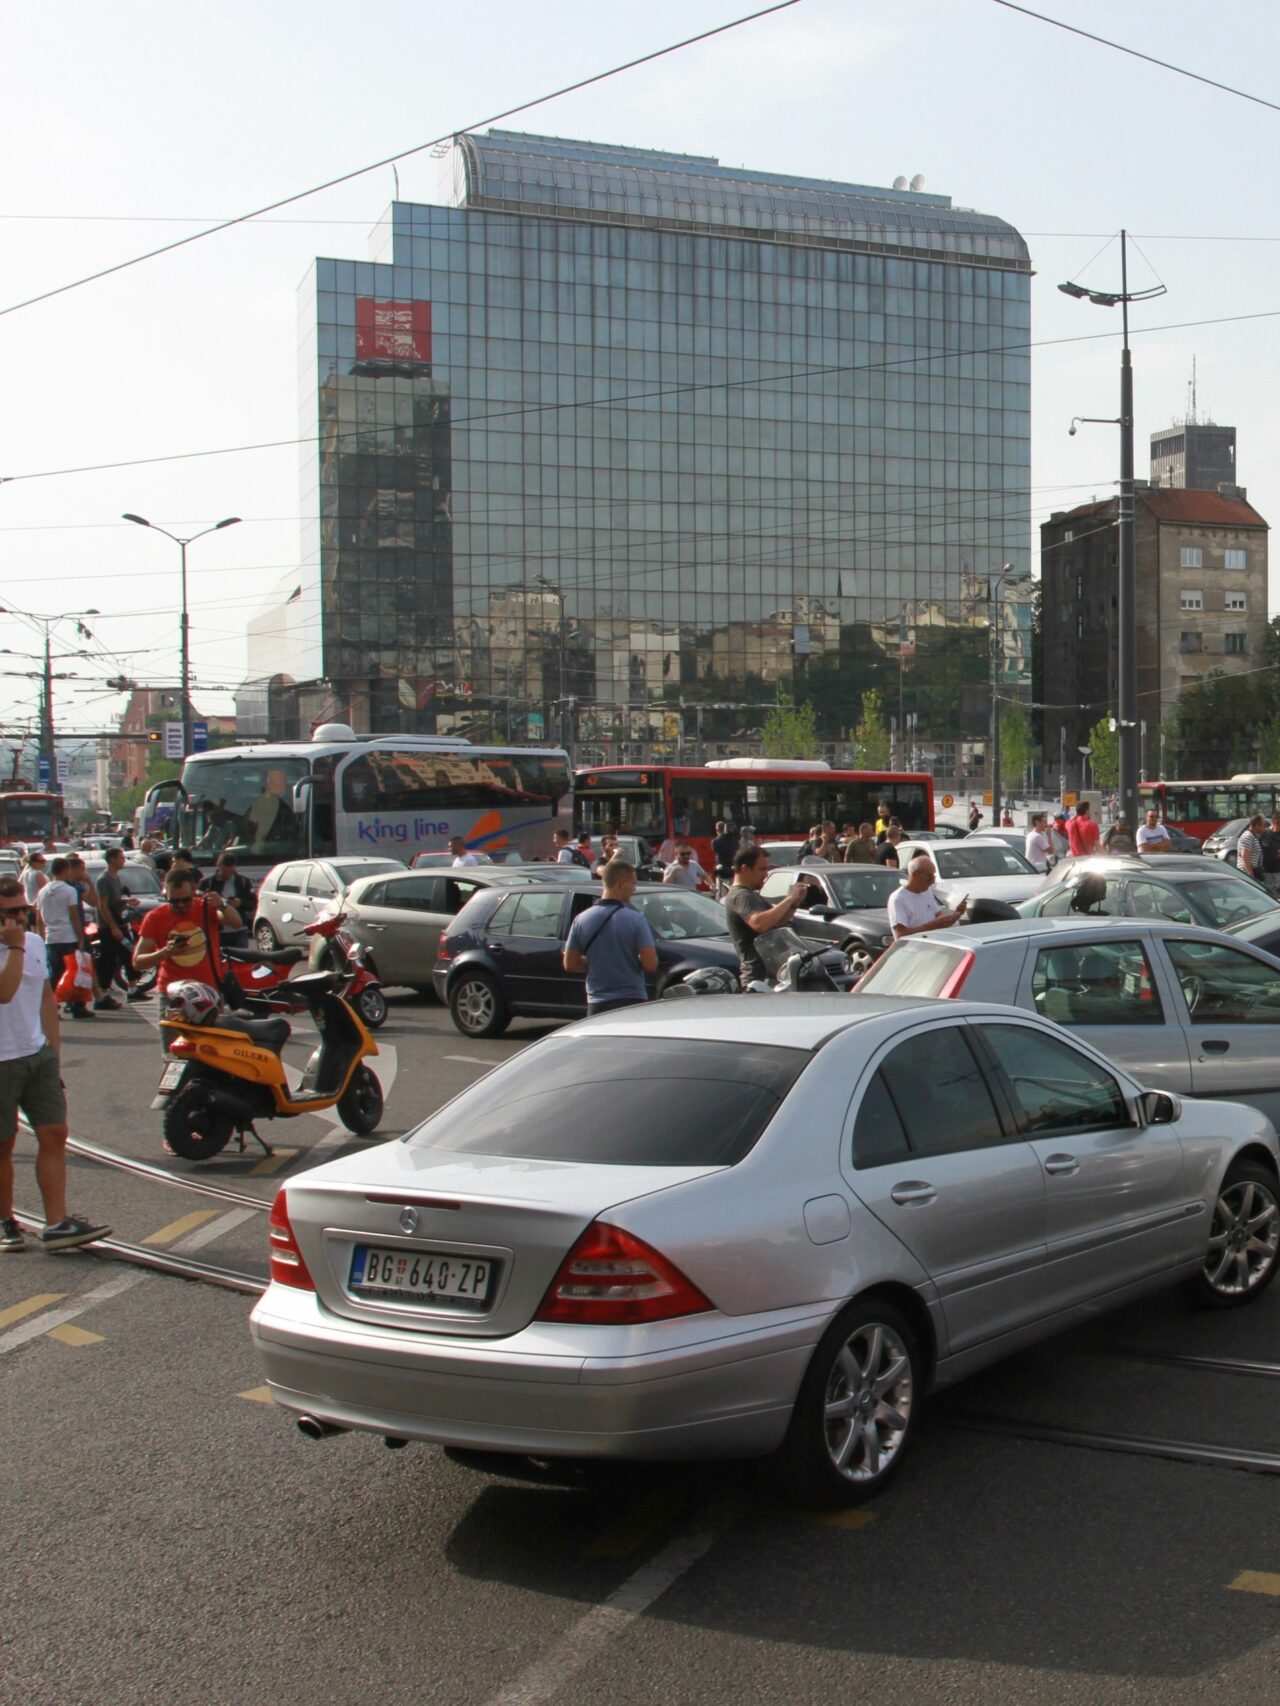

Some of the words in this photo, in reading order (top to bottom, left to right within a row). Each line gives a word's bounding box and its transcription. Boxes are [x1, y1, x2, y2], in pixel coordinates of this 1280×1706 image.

[358, 816, 407, 844] king
[414, 818, 449, 841] line
[233, 1048, 268, 1062] GILERA
[367, 1253, 394, 1283] BG
